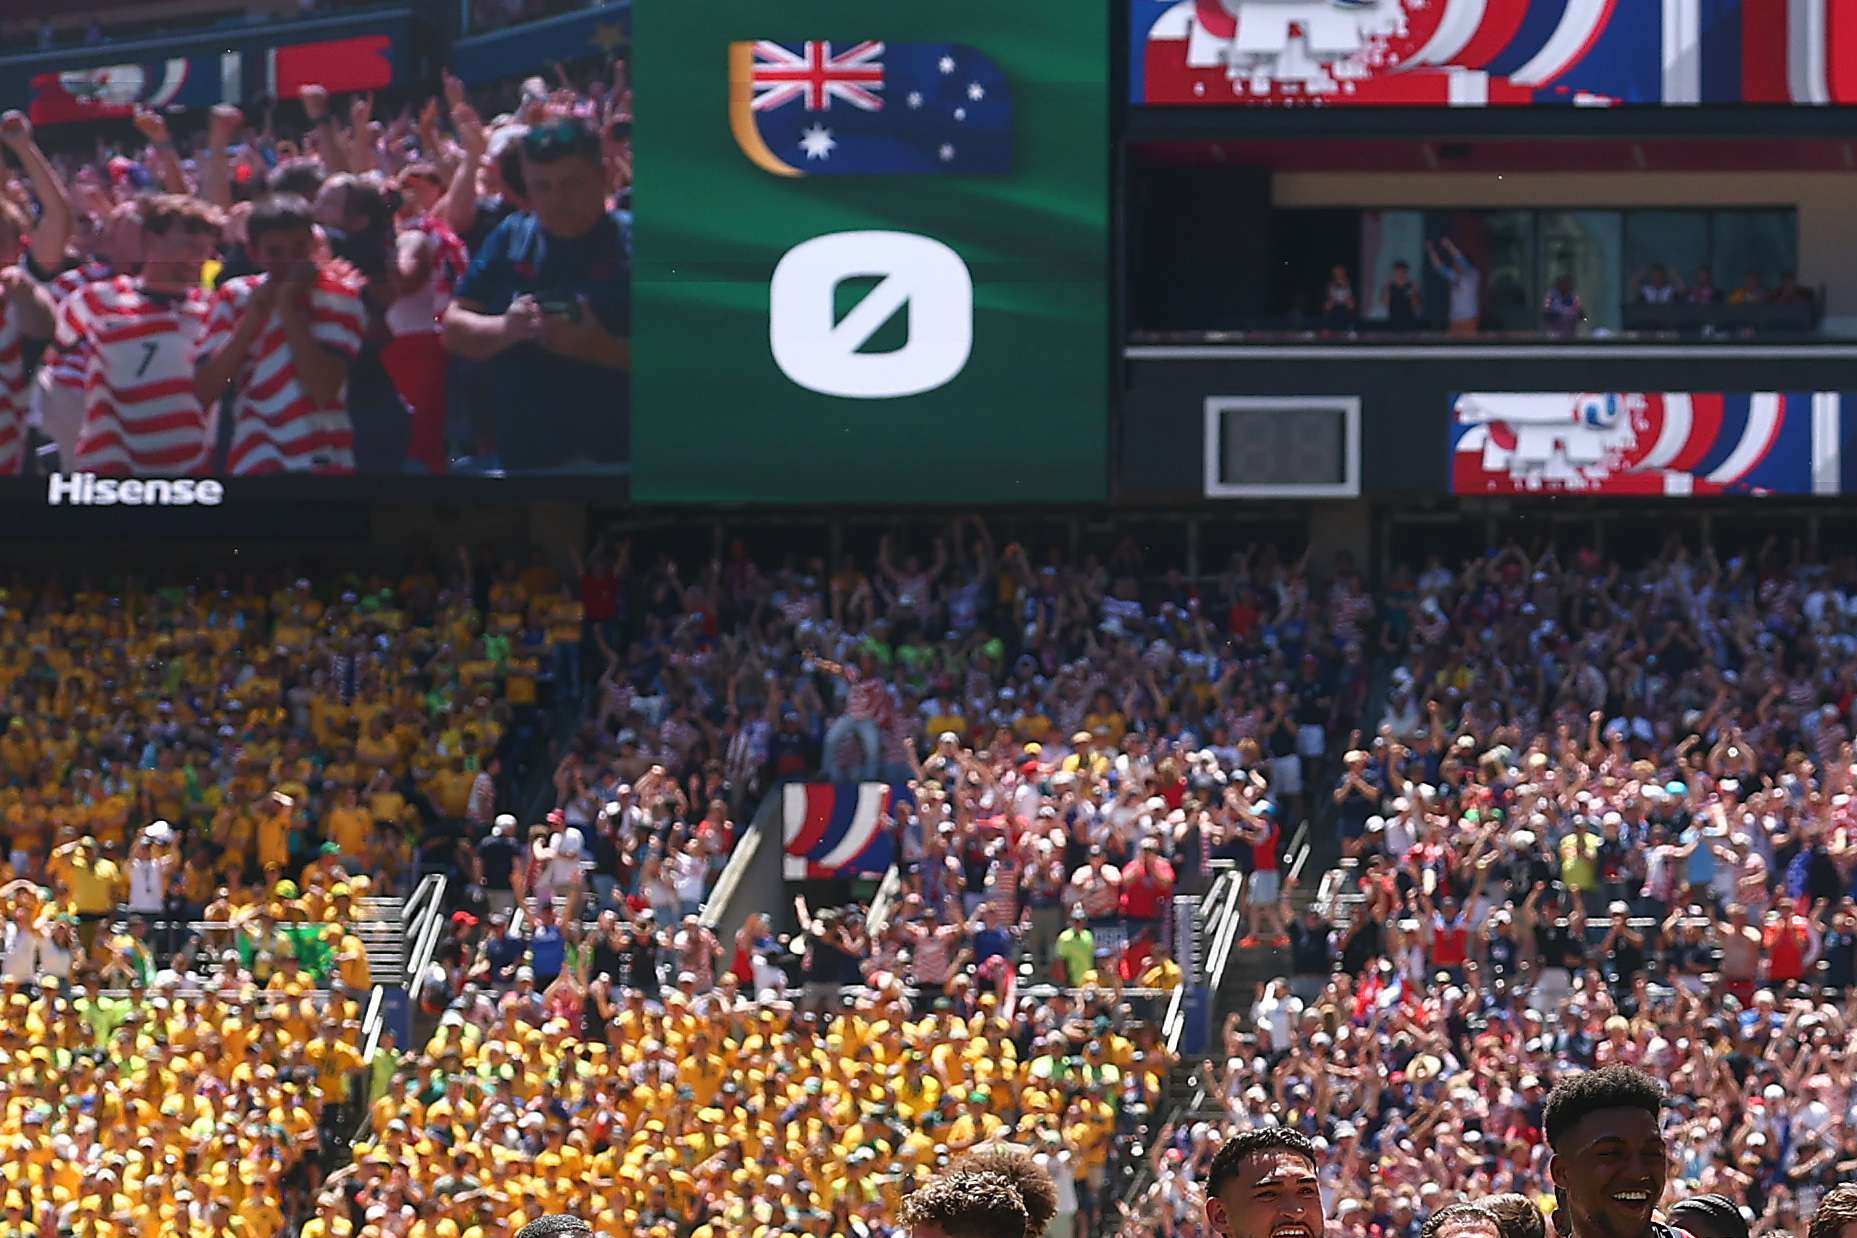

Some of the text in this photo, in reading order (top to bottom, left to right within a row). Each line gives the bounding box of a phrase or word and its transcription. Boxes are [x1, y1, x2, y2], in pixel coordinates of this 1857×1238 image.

[770, 230, 973, 398] 0
[135, 341, 159, 378] 7
[48, 472, 224, 505] Hisense
